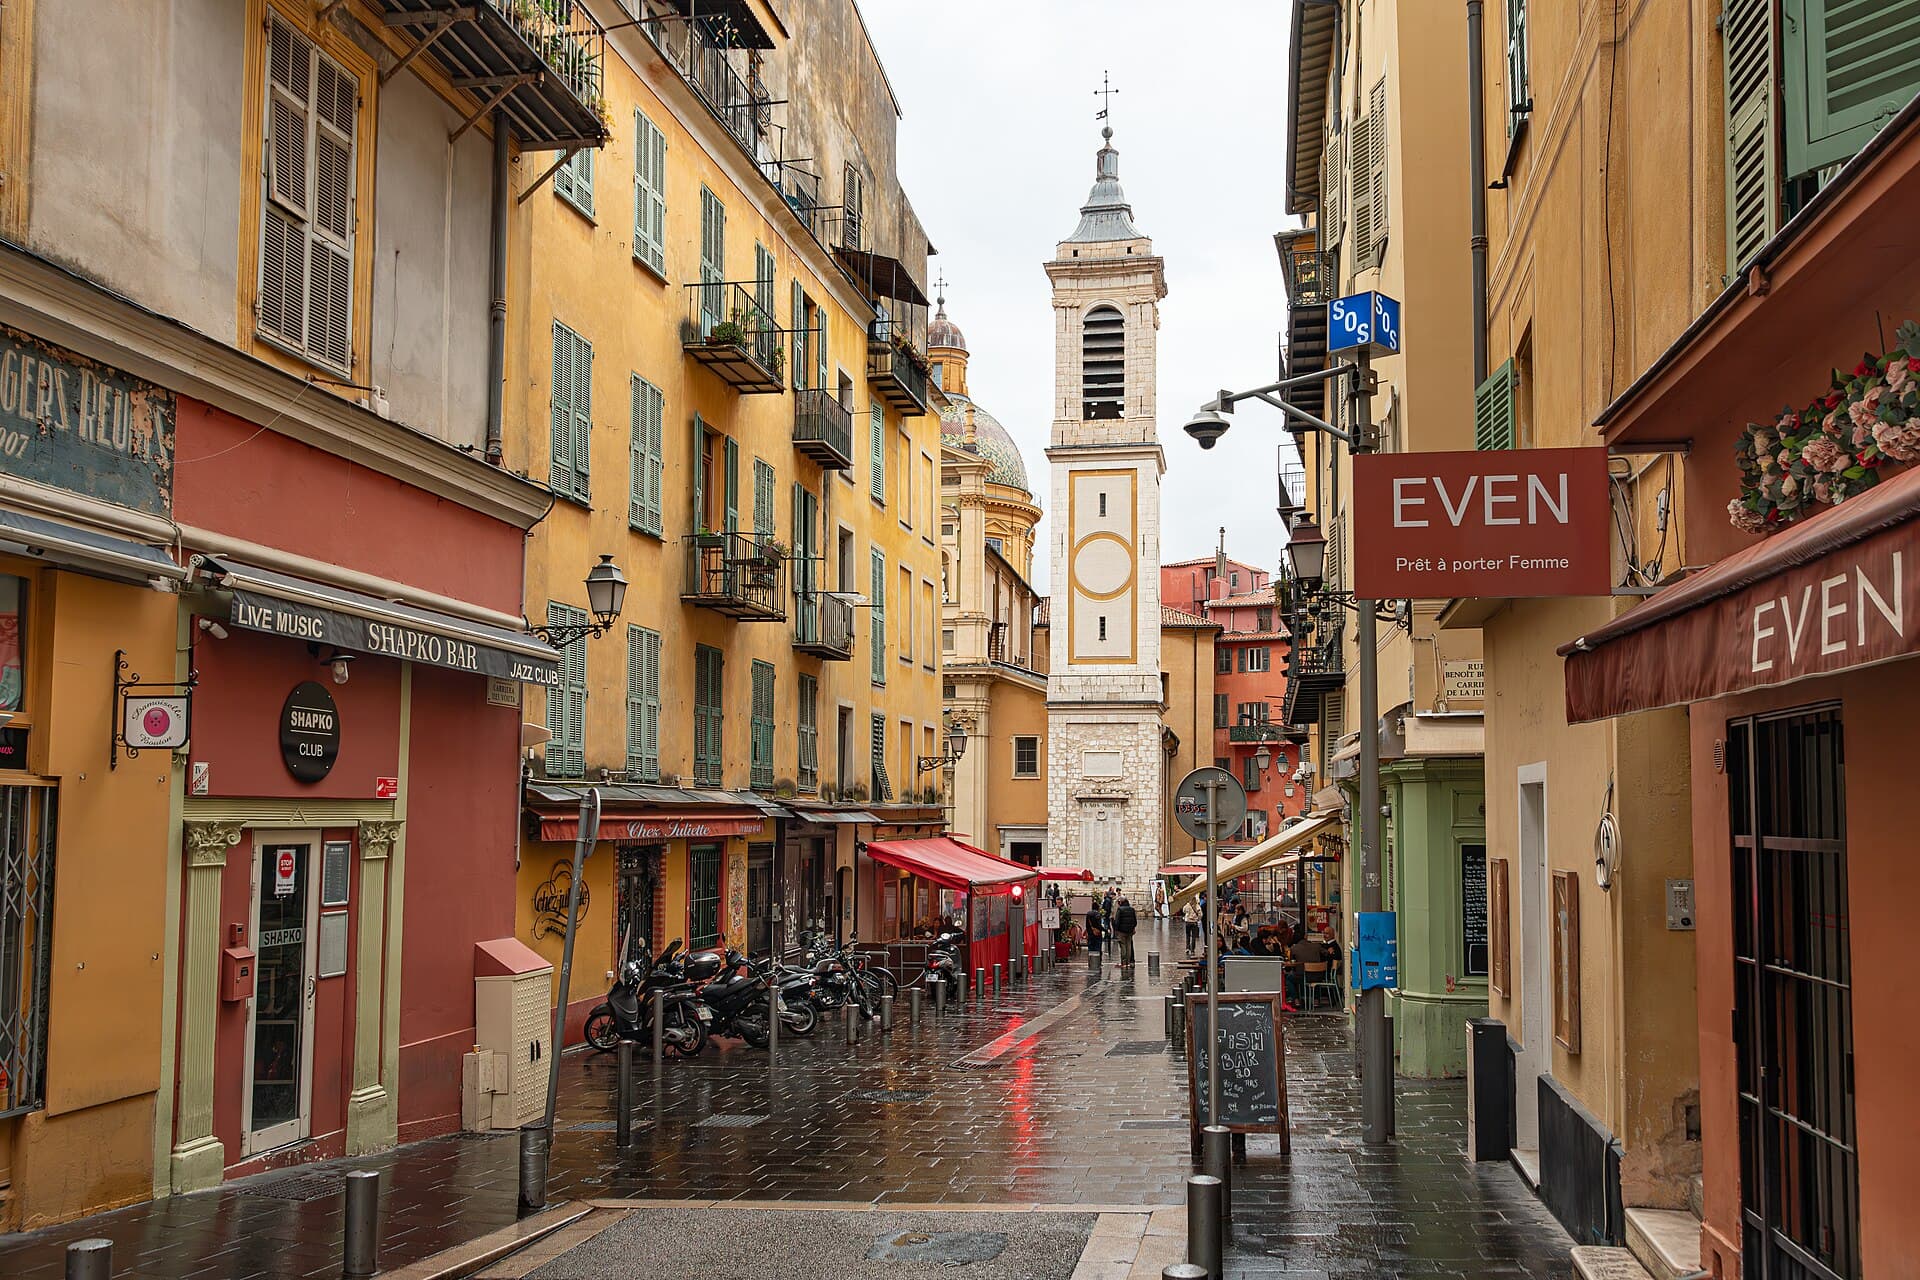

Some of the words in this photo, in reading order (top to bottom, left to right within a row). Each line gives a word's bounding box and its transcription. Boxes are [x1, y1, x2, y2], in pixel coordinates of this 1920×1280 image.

[1332, 300, 1369, 344] SOS
[1375, 294, 1397, 350] SOS
[1393, 473, 1569, 528] EVEN
[1396, 556, 1432, 572] Prêt
[1437, 557, 1447, 570] à
[1453, 557, 1504, 573] porter
[1509, 555, 1569, 570] Femme
[238, 603, 272, 629] LIVE
[276, 611, 323, 638] MUSIC
[1752, 551, 1904, 673] EVEN
[367, 623, 442, 662] SHAPKO
[446, 640, 478, 670] BAR
[510, 662, 533, 681] JAZZ
[535, 667, 559, 685] CLUB
[290, 710, 333, 730] SHAPKO
[299, 742, 323, 757] CLUB
[626, 820, 661, 838] Chez
[664, 821, 711, 838] Juliette
[263, 928, 302, 946] SHAPKO
[1221, 1050, 1259, 1071] BAR
